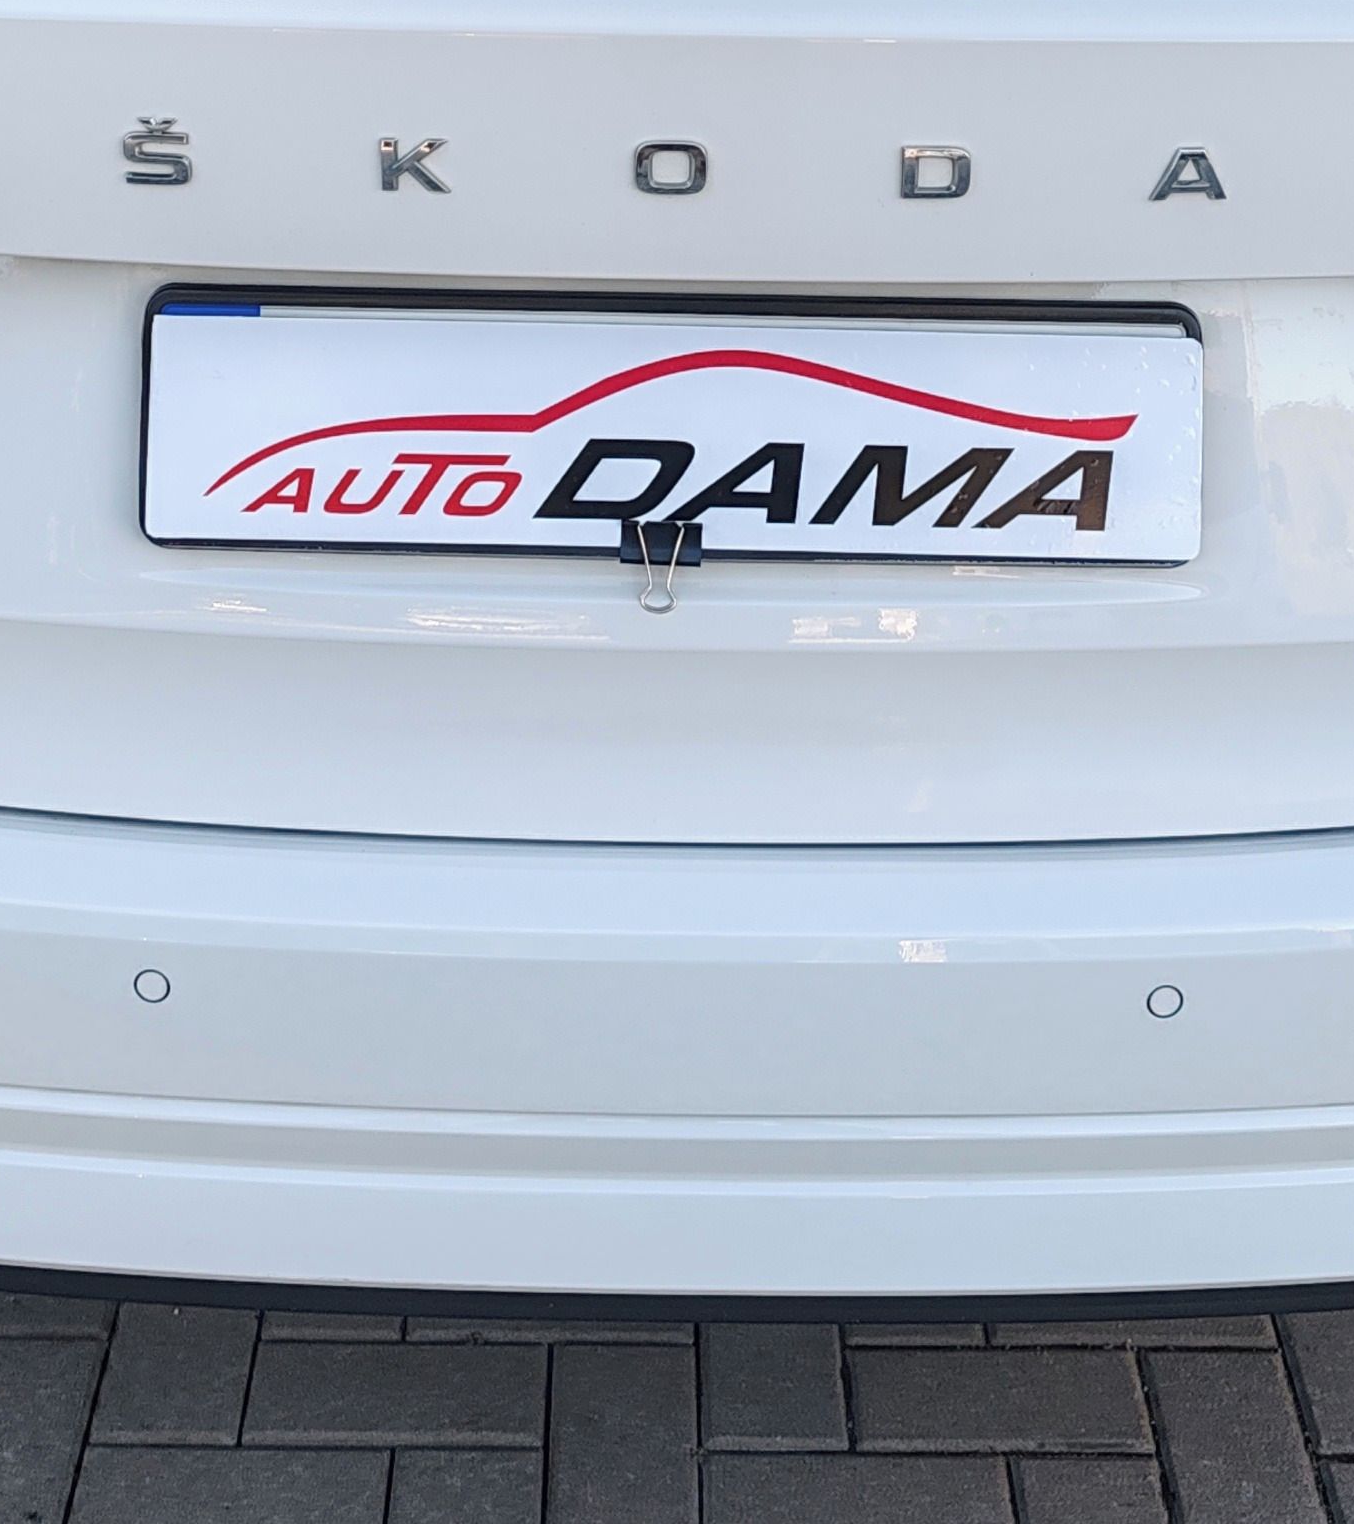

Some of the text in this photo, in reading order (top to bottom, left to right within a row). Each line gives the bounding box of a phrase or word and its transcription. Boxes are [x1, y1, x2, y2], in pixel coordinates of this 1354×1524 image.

[120, 116, 1228, 203] ŠKODA
[244, 437, 1115, 532] AUTO DAMA
